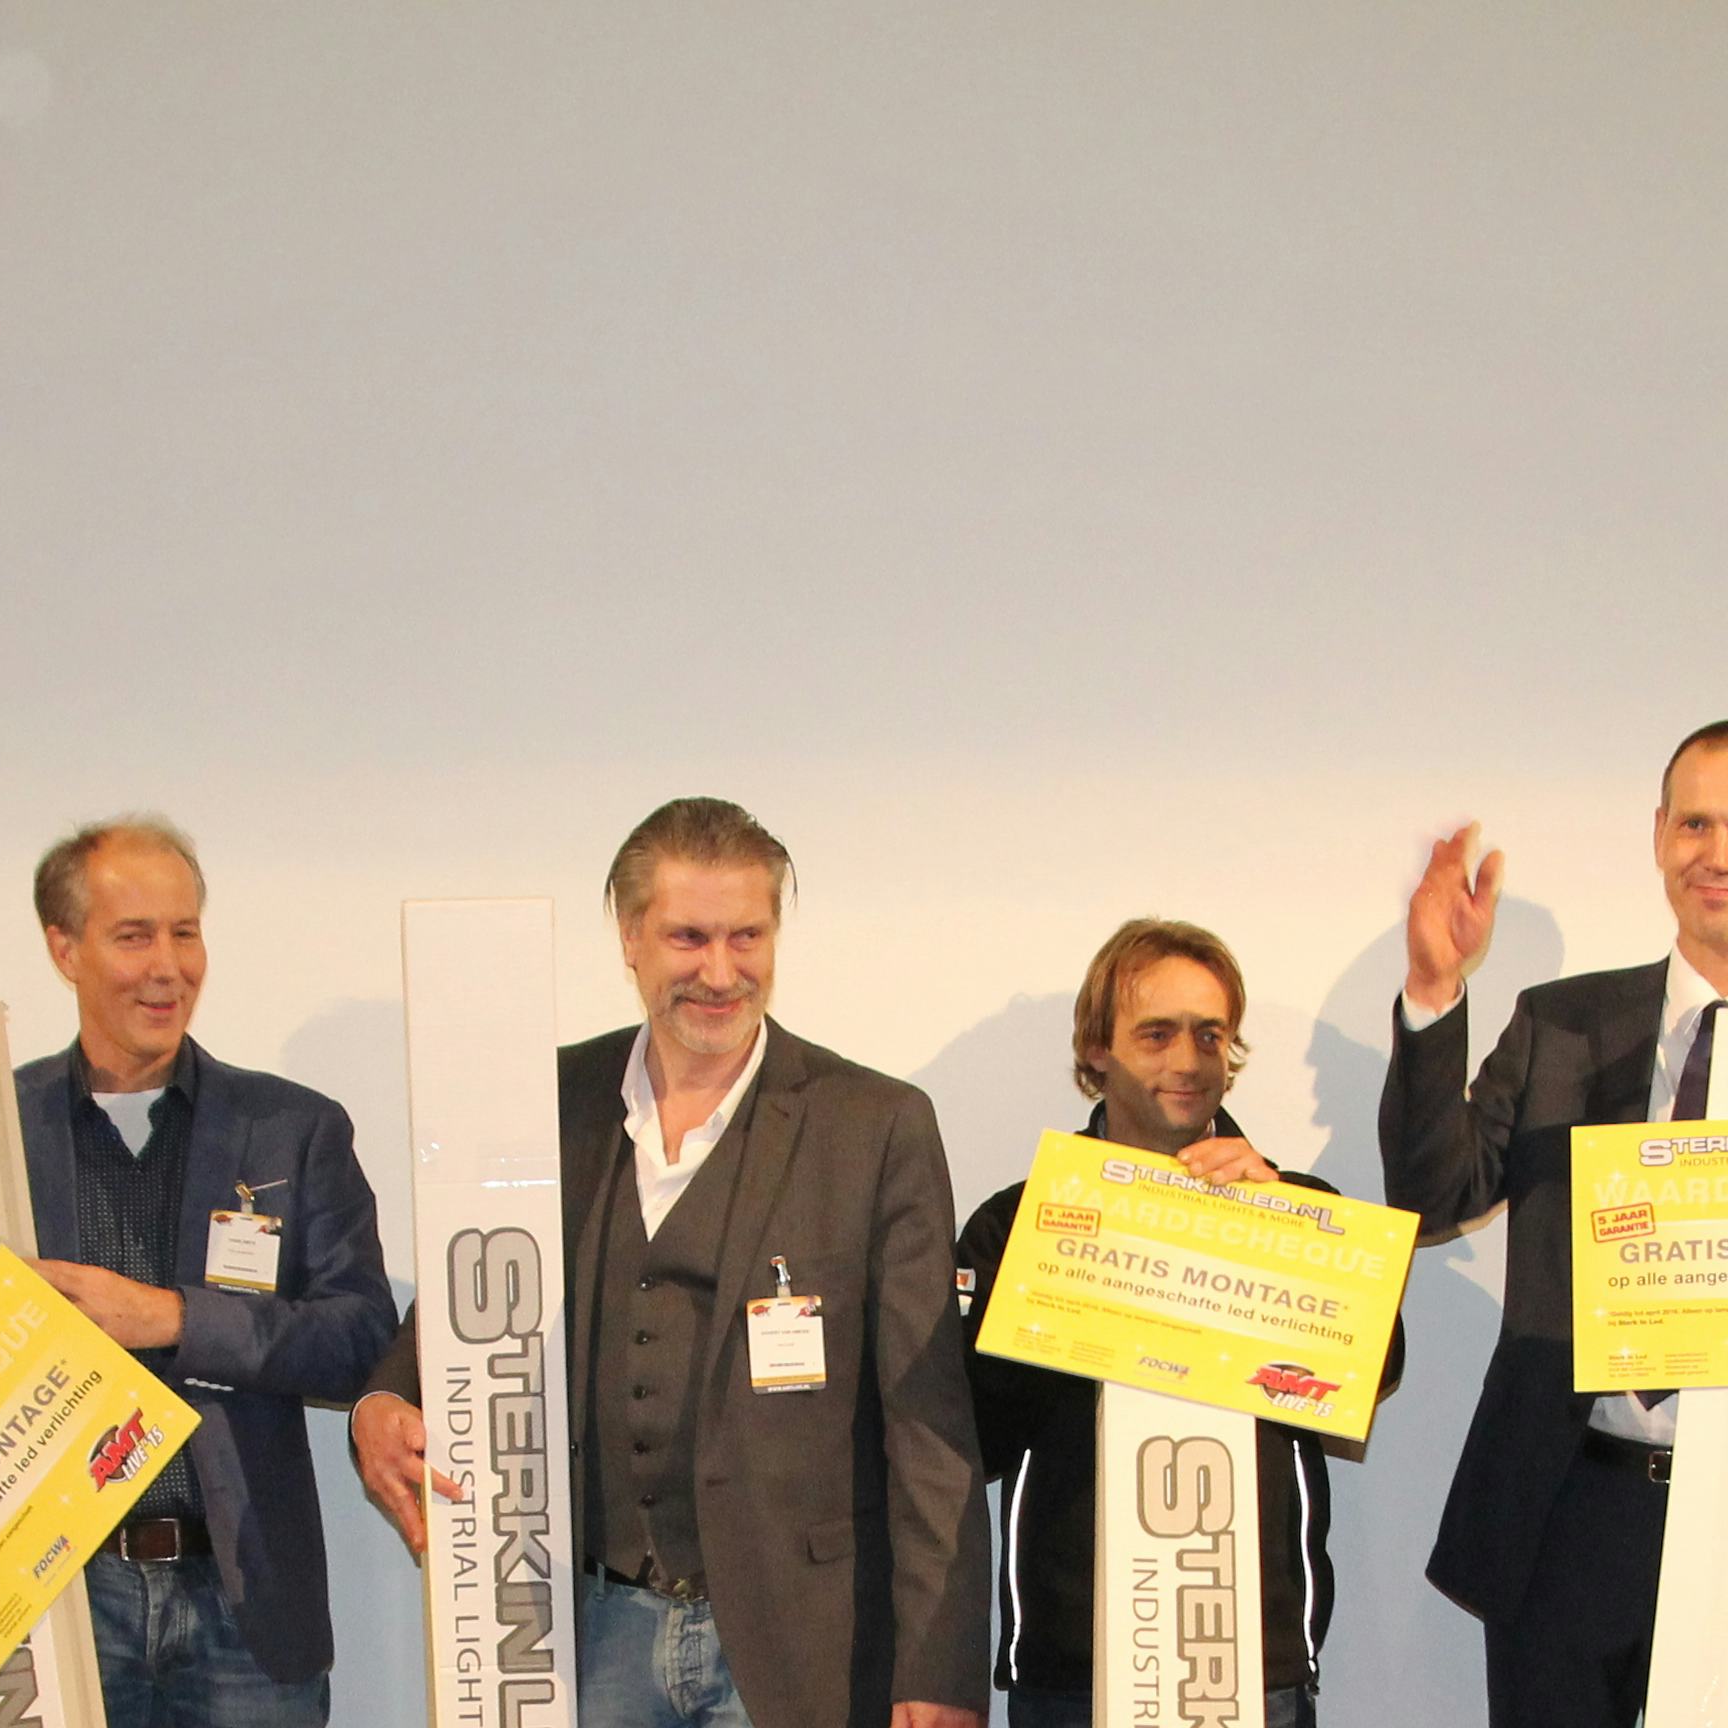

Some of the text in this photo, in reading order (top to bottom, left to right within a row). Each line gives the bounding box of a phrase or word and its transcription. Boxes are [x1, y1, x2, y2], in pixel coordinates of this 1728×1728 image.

[1047, 1180, 1389, 1281] WAARDECHEQUE
[1597, 1208, 1648, 1226] 5 JAAR
[1598, 1221, 1650, 1238] GARANTIE
[1056, 1237, 1171, 1280] GRATIS
[1608, 1273, 1630, 1289] op
[1636, 1270, 1667, 1287] alle
[1038, 1263, 1060, 1278] op
[1064, 1264, 1096, 1285] alle
[1101, 1275, 1222, 1315] aangeschafte
[1226, 1304, 1256, 1322] led
[1260, 1312, 1354, 1346] verlichting
[1245, 1364, 1341, 1400] AMT
[14, 1445, 40, 1476] led
[36, 1368, 105, 1448] verlichting
[87, 1407, 146, 1493] AMT
[445, 1365, 484, 1603] INDUSTRIAL
[32, 1534, 71, 1580] FOCWA
